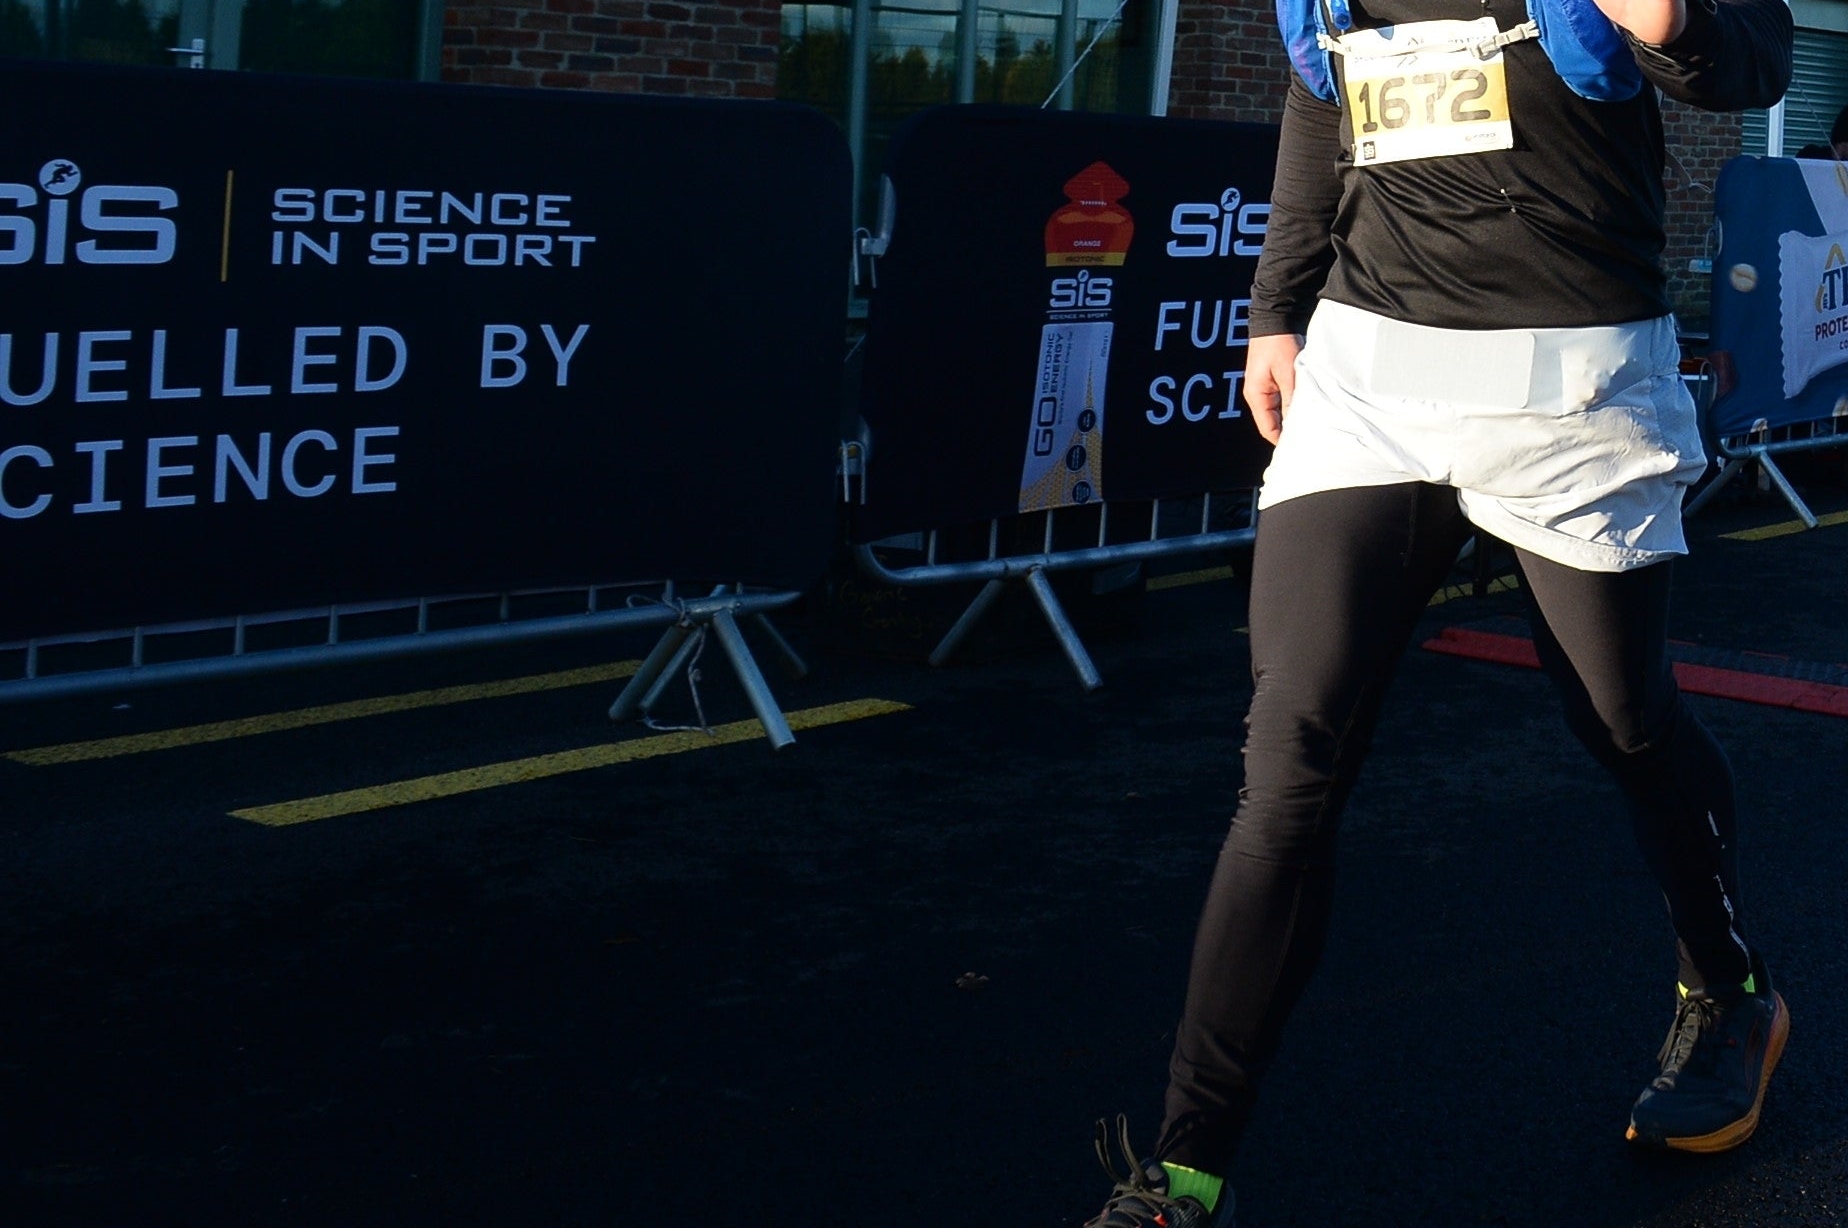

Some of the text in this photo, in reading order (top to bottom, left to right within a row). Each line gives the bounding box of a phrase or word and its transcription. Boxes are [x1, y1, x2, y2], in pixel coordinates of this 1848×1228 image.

[1358, 68, 1491, 133] 1672
[272, 188, 572, 227] SCIENCE
[272, 231, 596, 267] IN SPORT
[1050, 270, 1113, 308] SiS
[1050, 313, 1077, 321] SCIENCE
[480, 324, 590, 388] BY
[1042, 332, 1055, 394] ISOTONIC
[1050, 332, 1065, 394] ENERGY
[1033, 395, 1057, 457] GO
